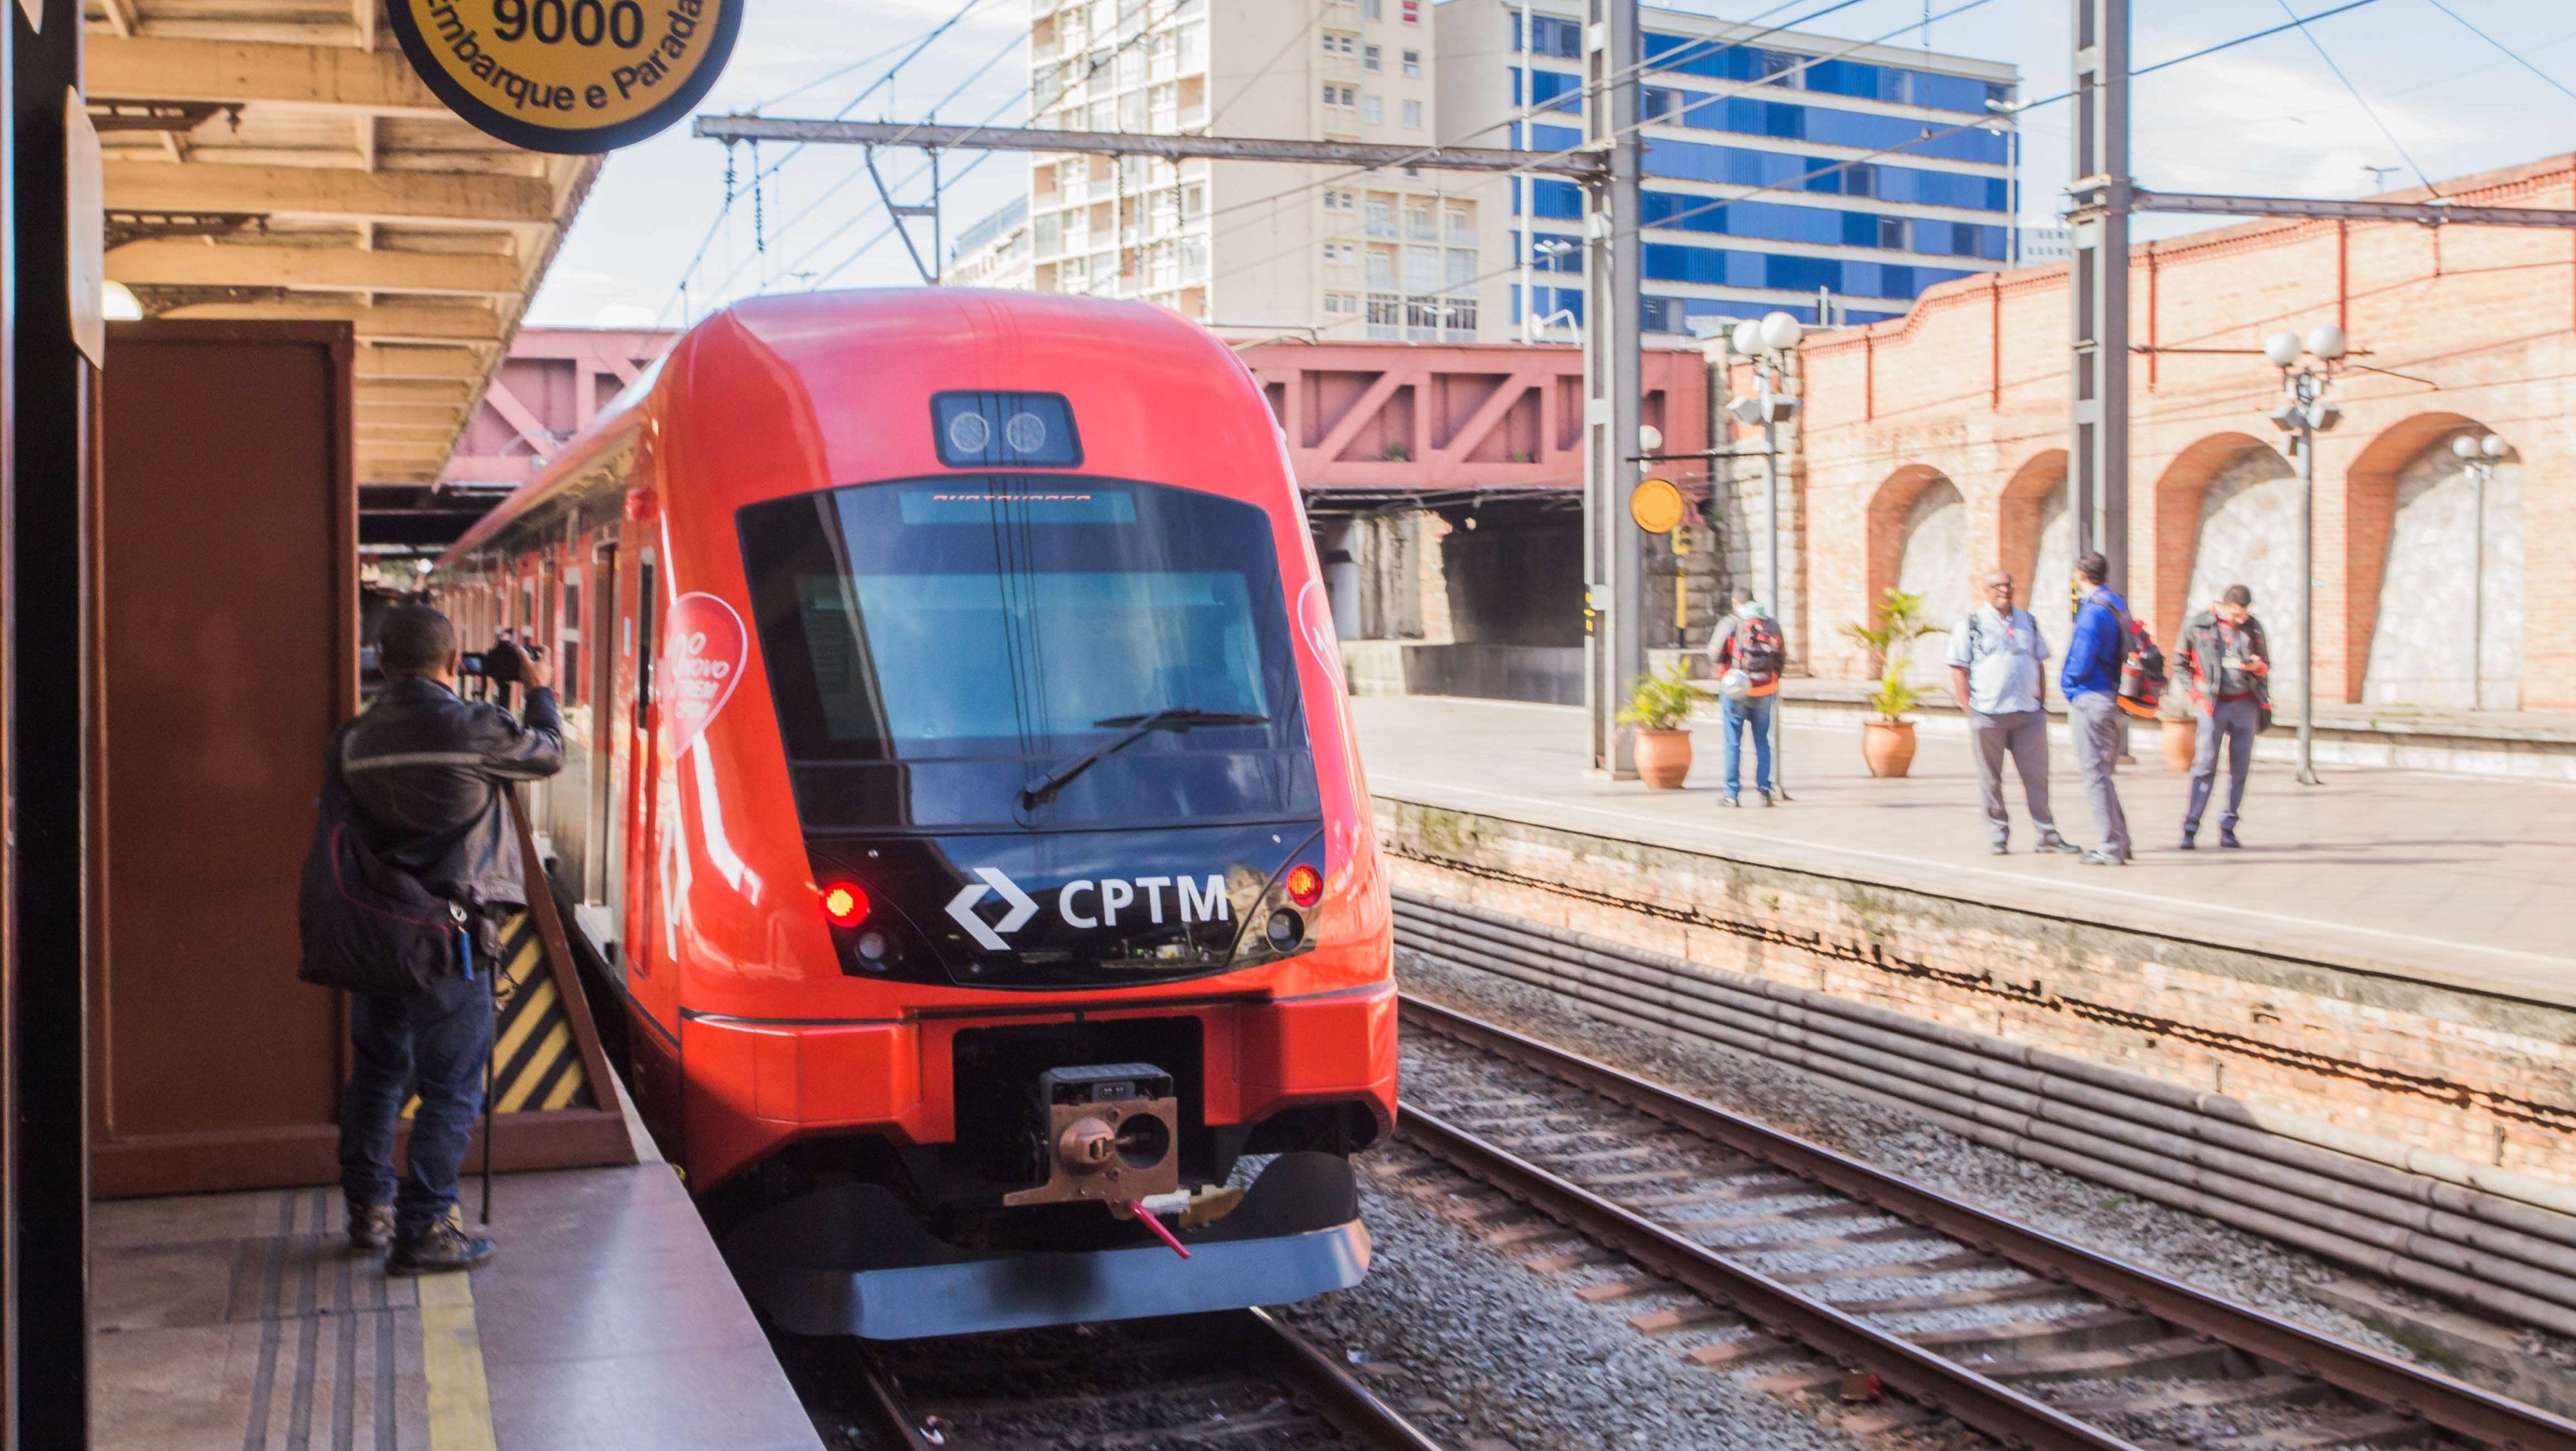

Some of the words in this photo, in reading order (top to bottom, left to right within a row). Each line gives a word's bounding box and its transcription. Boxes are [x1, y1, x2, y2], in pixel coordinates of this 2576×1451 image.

[493, 0, 643, 48] 9000
[428, 0, 575, 111] mbarque
[584, 84, 607, 108] e
[612, 0, 703, 100] Parada
[1059, 875, 1229, 929] CPTM
